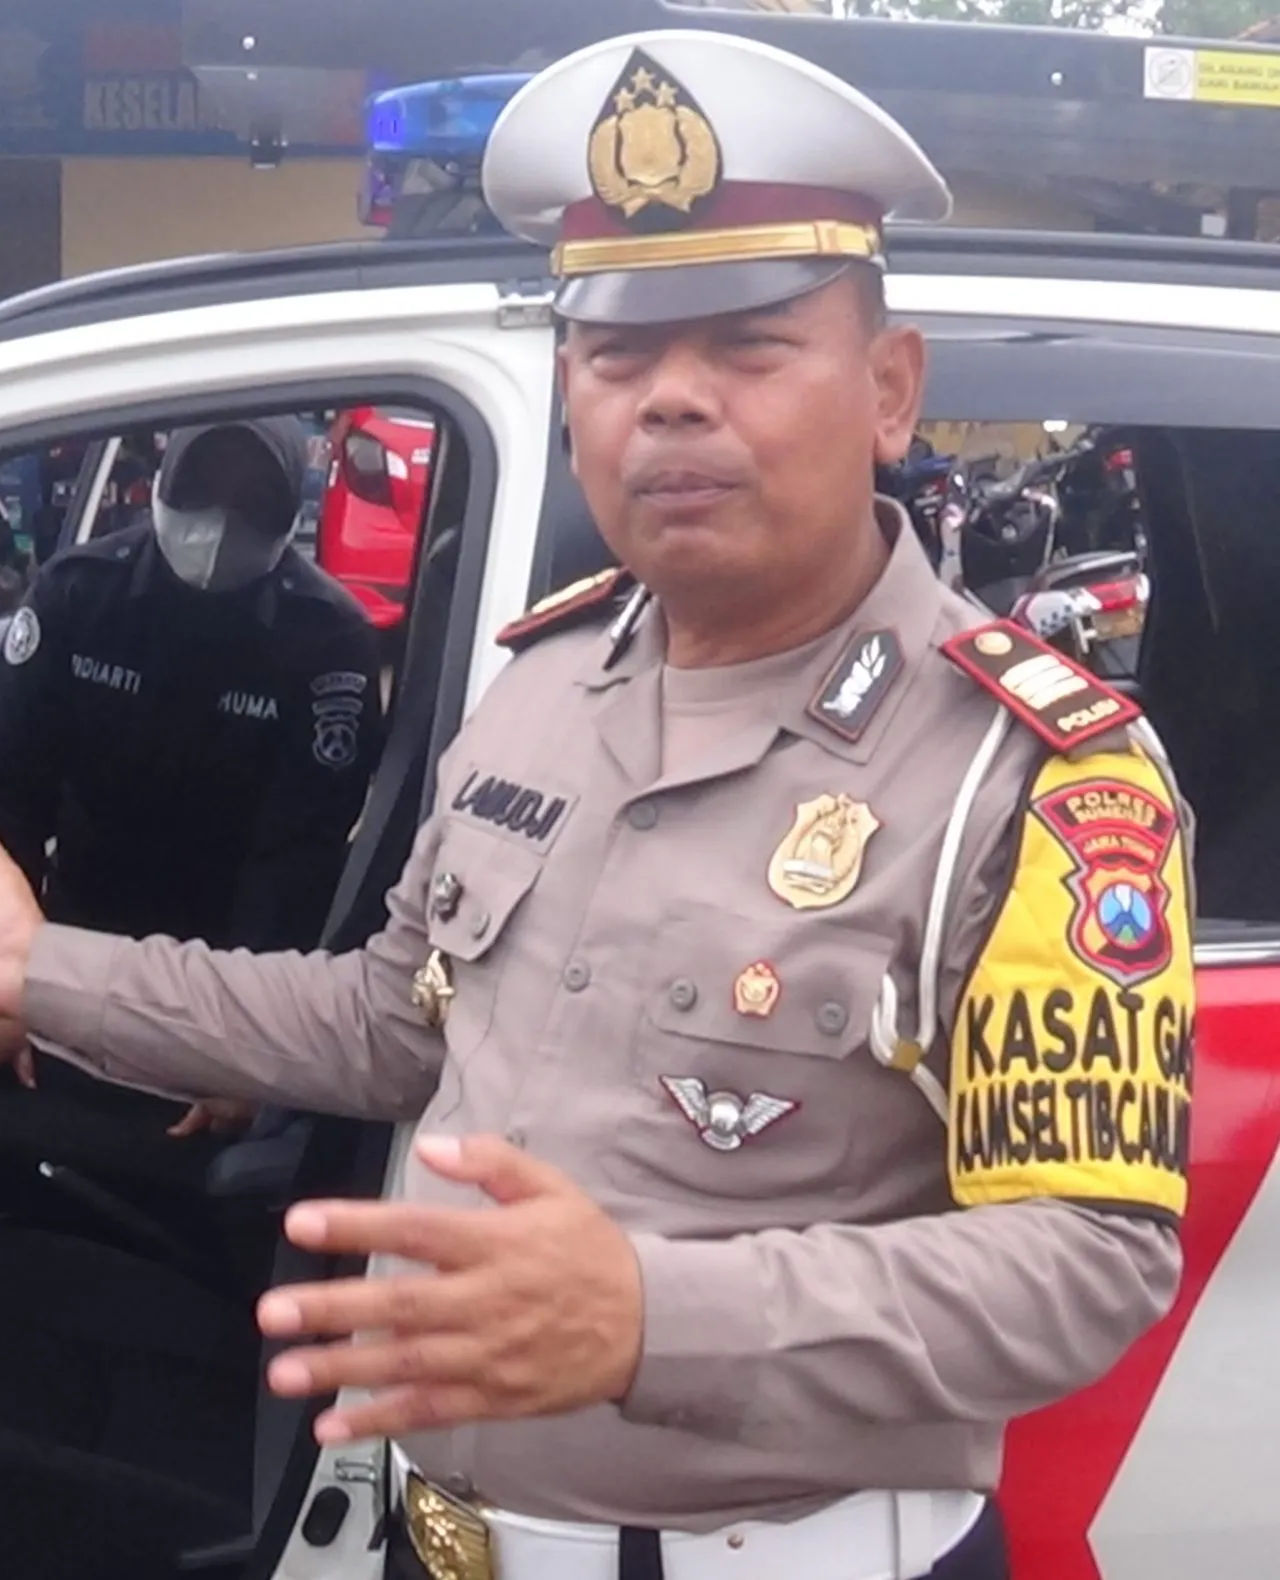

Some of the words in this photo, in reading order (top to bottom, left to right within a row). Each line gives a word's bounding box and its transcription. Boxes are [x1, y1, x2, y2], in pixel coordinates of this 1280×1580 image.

[1057, 698, 1121, 732] POLISI
[1066, 790, 1156, 817] POLRES
[966, 986, 1145, 1081] KASAT
